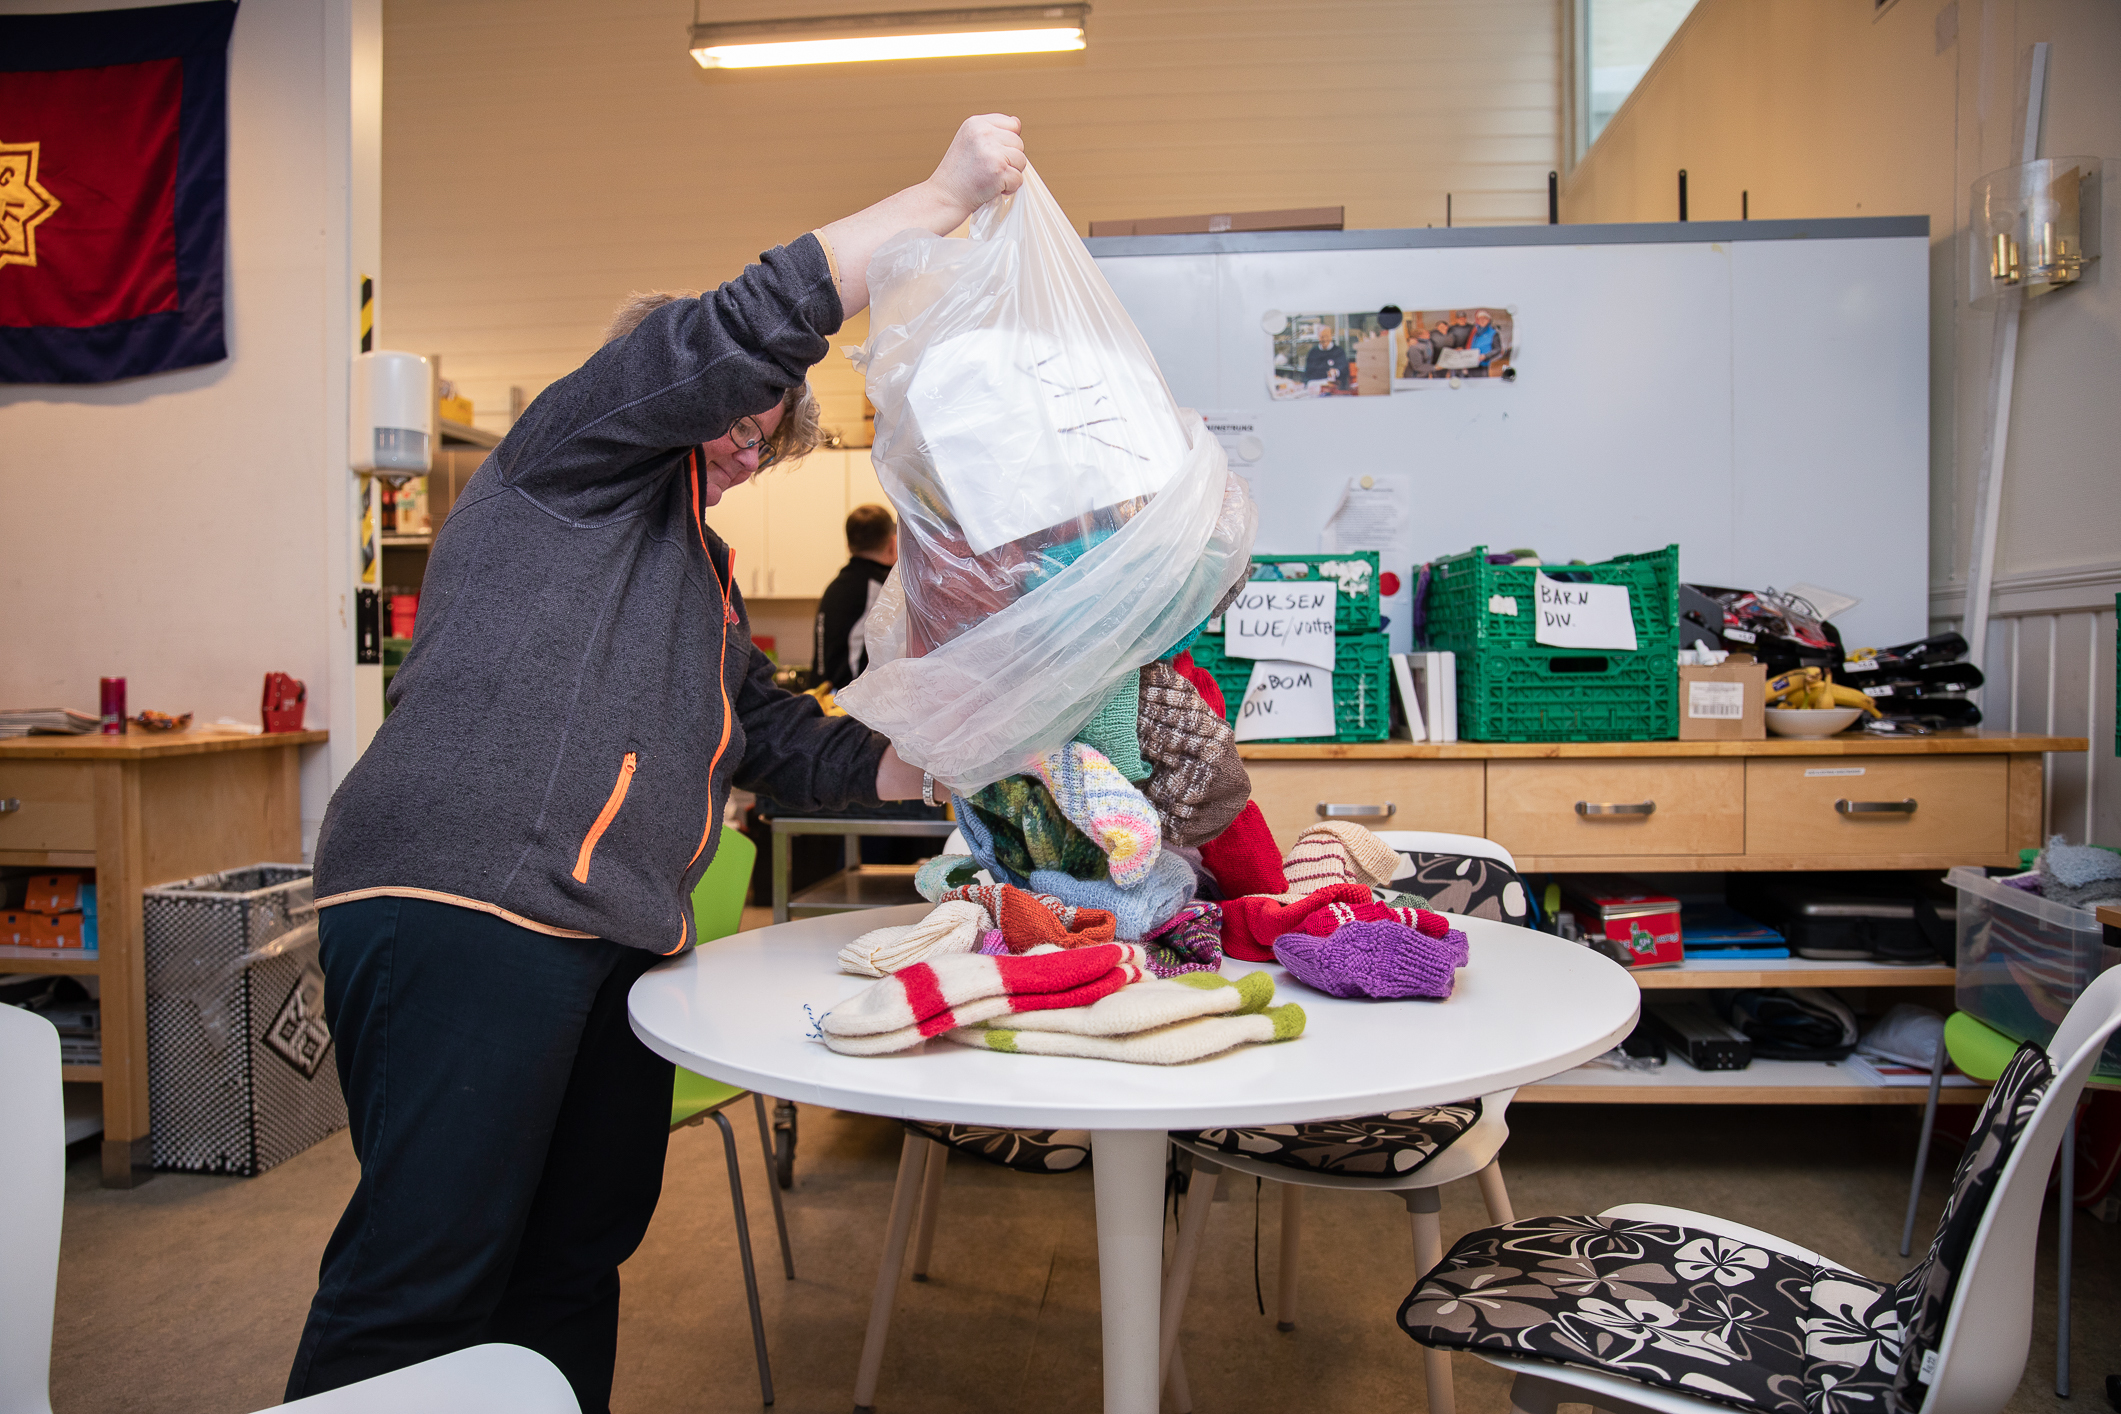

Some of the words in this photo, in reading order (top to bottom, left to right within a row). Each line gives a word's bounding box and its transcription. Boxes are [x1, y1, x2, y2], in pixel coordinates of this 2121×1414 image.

[1235, 594, 1325, 610] VOKSEN
[1541, 585, 1588, 605] BARN
[1544, 611, 1576, 627] DIV.
[1244, 700, 1278, 717] DIV.
